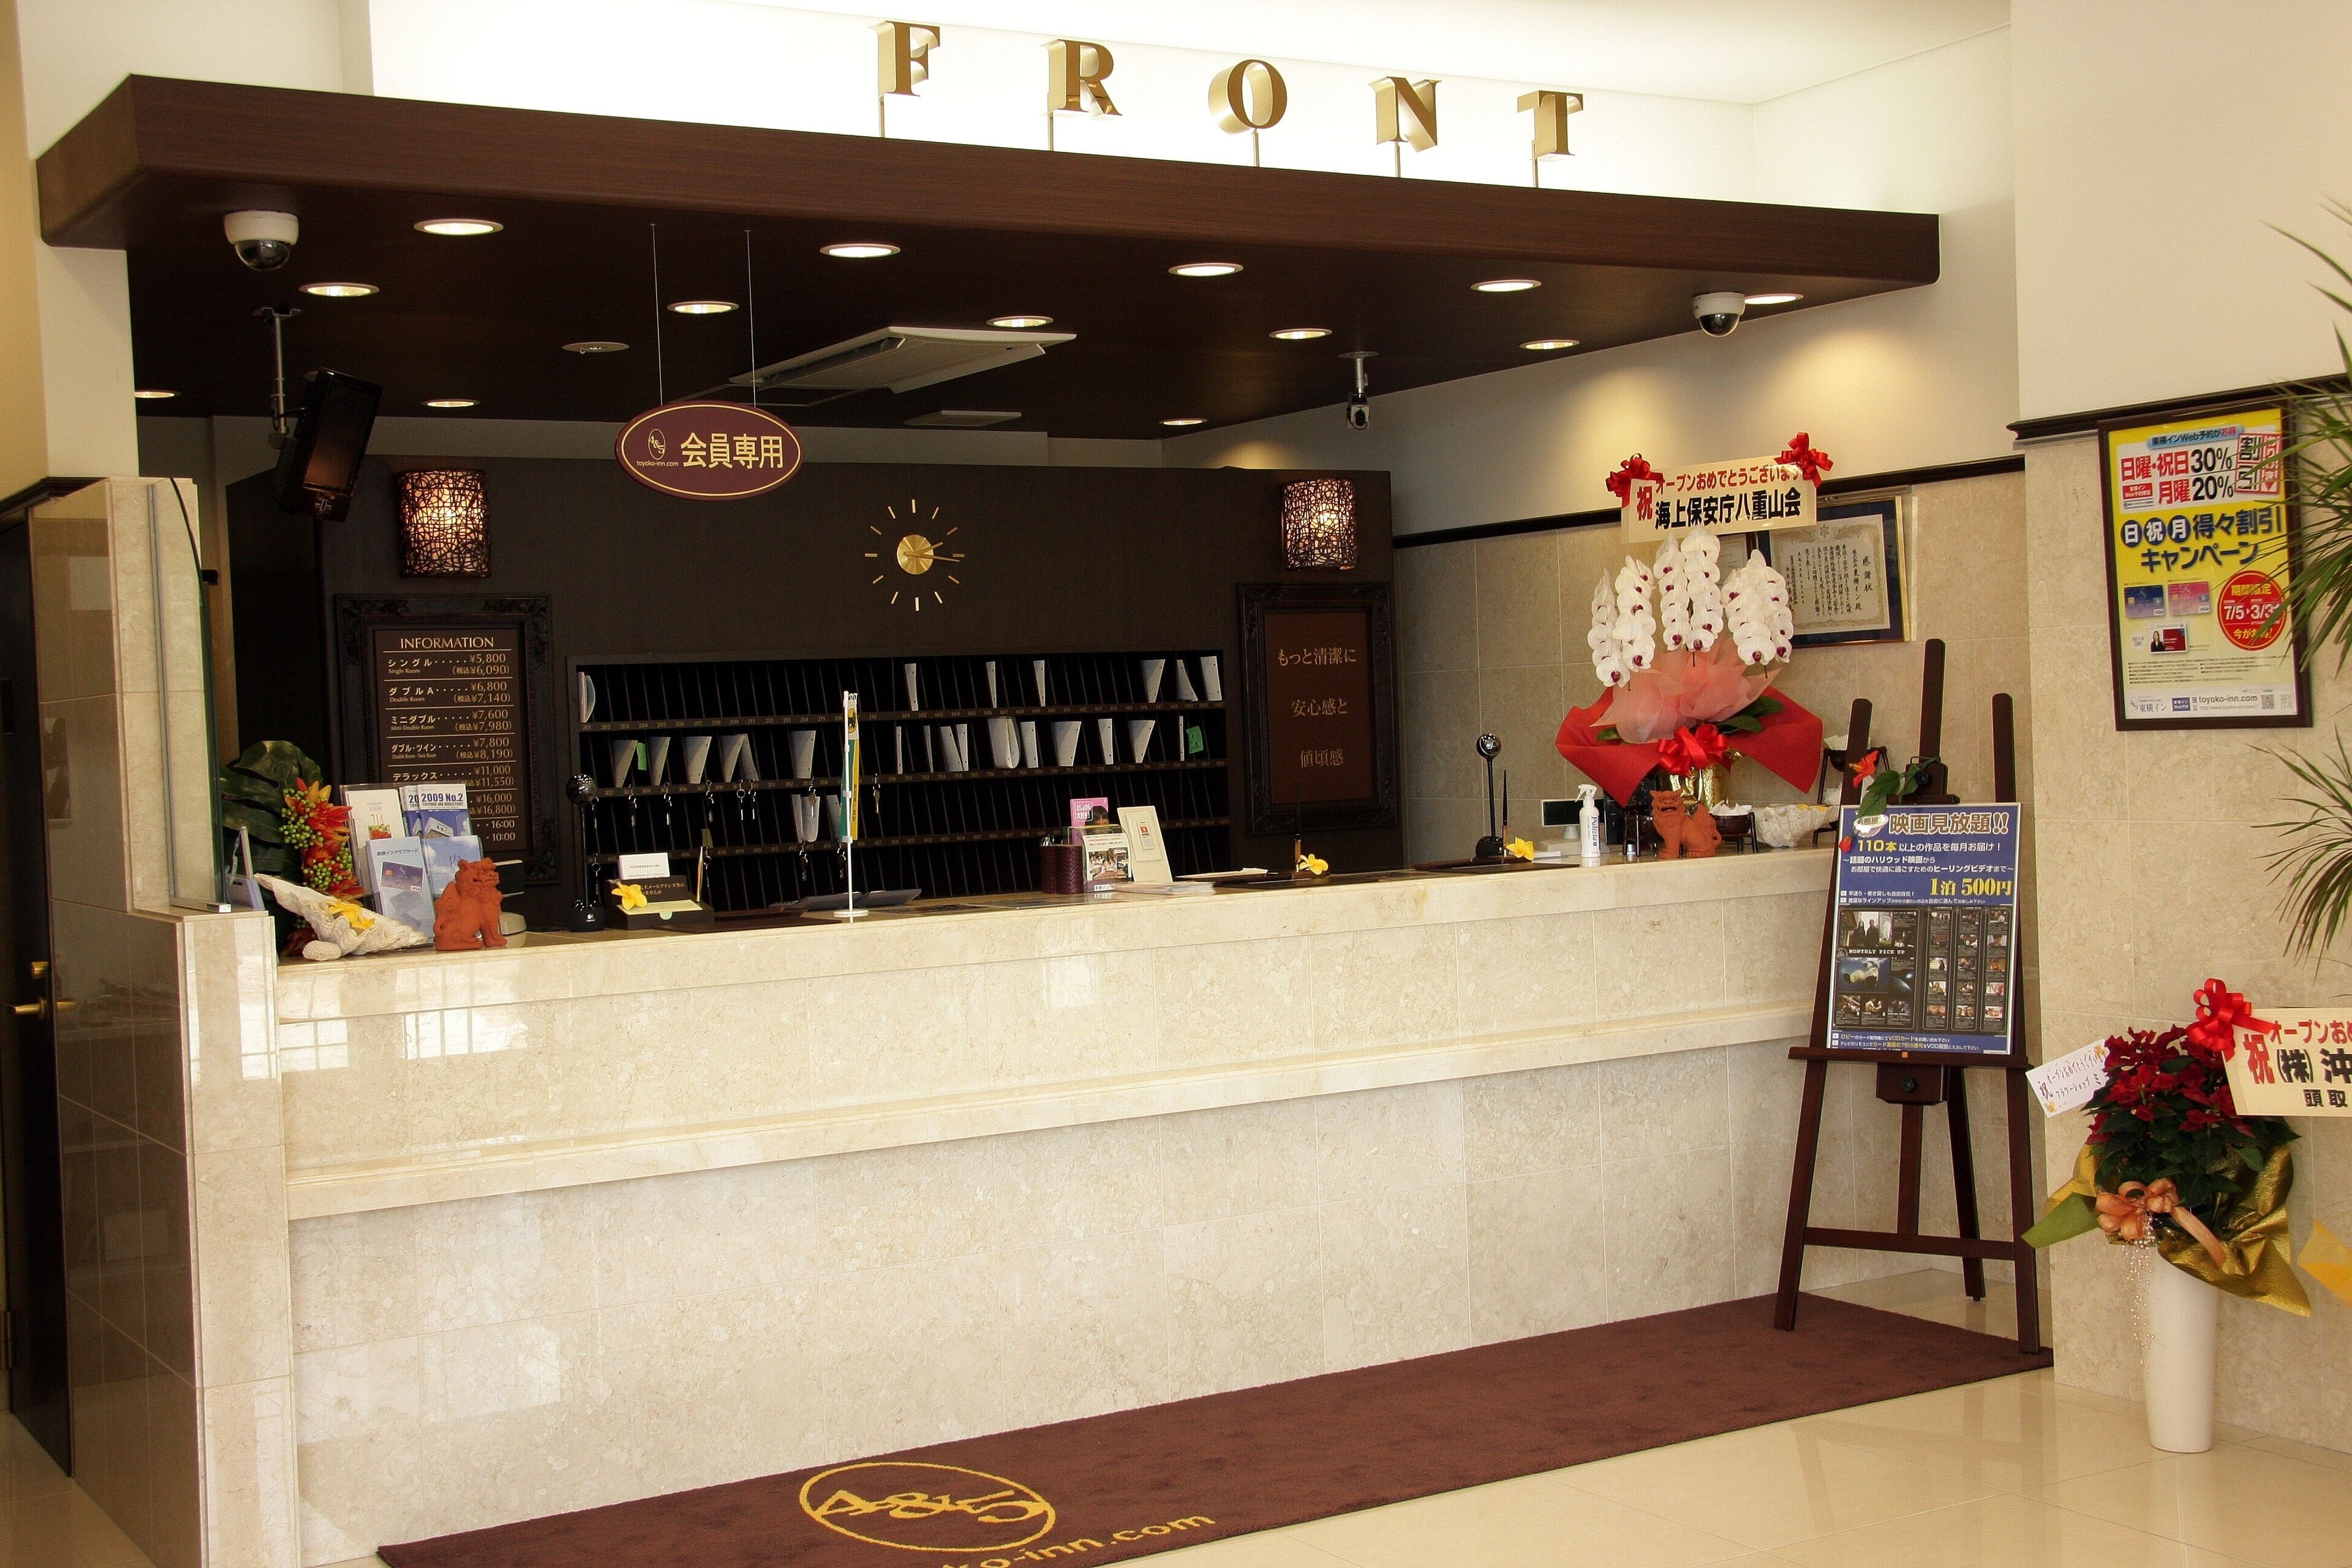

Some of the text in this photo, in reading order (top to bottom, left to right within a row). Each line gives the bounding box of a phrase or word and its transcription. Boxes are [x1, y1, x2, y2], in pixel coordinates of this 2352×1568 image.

[870, 21, 1584, 158] FRONT
[680, 432, 783, 469] 会員専用
[2120, 450, 2189, 481] 日曜・祝日
[2190, 447, 2233, 473] 30%
[2158, 475, 2234, 505] 月曜 20%
[1637, 486, 1653, 521] 祝
[1656, 487, 1801, 530] 海上保安庁八重山会
[2141, 542, 2259, 572] キャンペーン
[2224, 605, 2244, 620] 7/5
[401, 637, 494, 649] INFORMATION
[470, 654, 506, 665] ¥5,800
[1278, 647, 1357, 666] もっと清潔に
[471, 681, 507, 692] ¥6,800
[1291, 698, 1348, 717] 安心感と
[2199, 695, 2258, 704] toyoko-inn.com
[472, 710, 508, 720] ¥7,600
[473, 737, 509, 748] ¥7,800
[393, 766, 510, 782] デラックス ¥11,000
[421, 793, 443, 802] 2009
[445, 793, 464, 802] No.2
[476, 793, 512, 804] ¥16,000
[1889, 812, 2009, 834] 映画見放題!!
[492, 832, 515, 841] 10:00
[1930, 878, 2012, 896] 1泊 500円
[2242, 1034, 2275, 1084] 祝
[2302, 1089, 2348, 1108] 頭取
